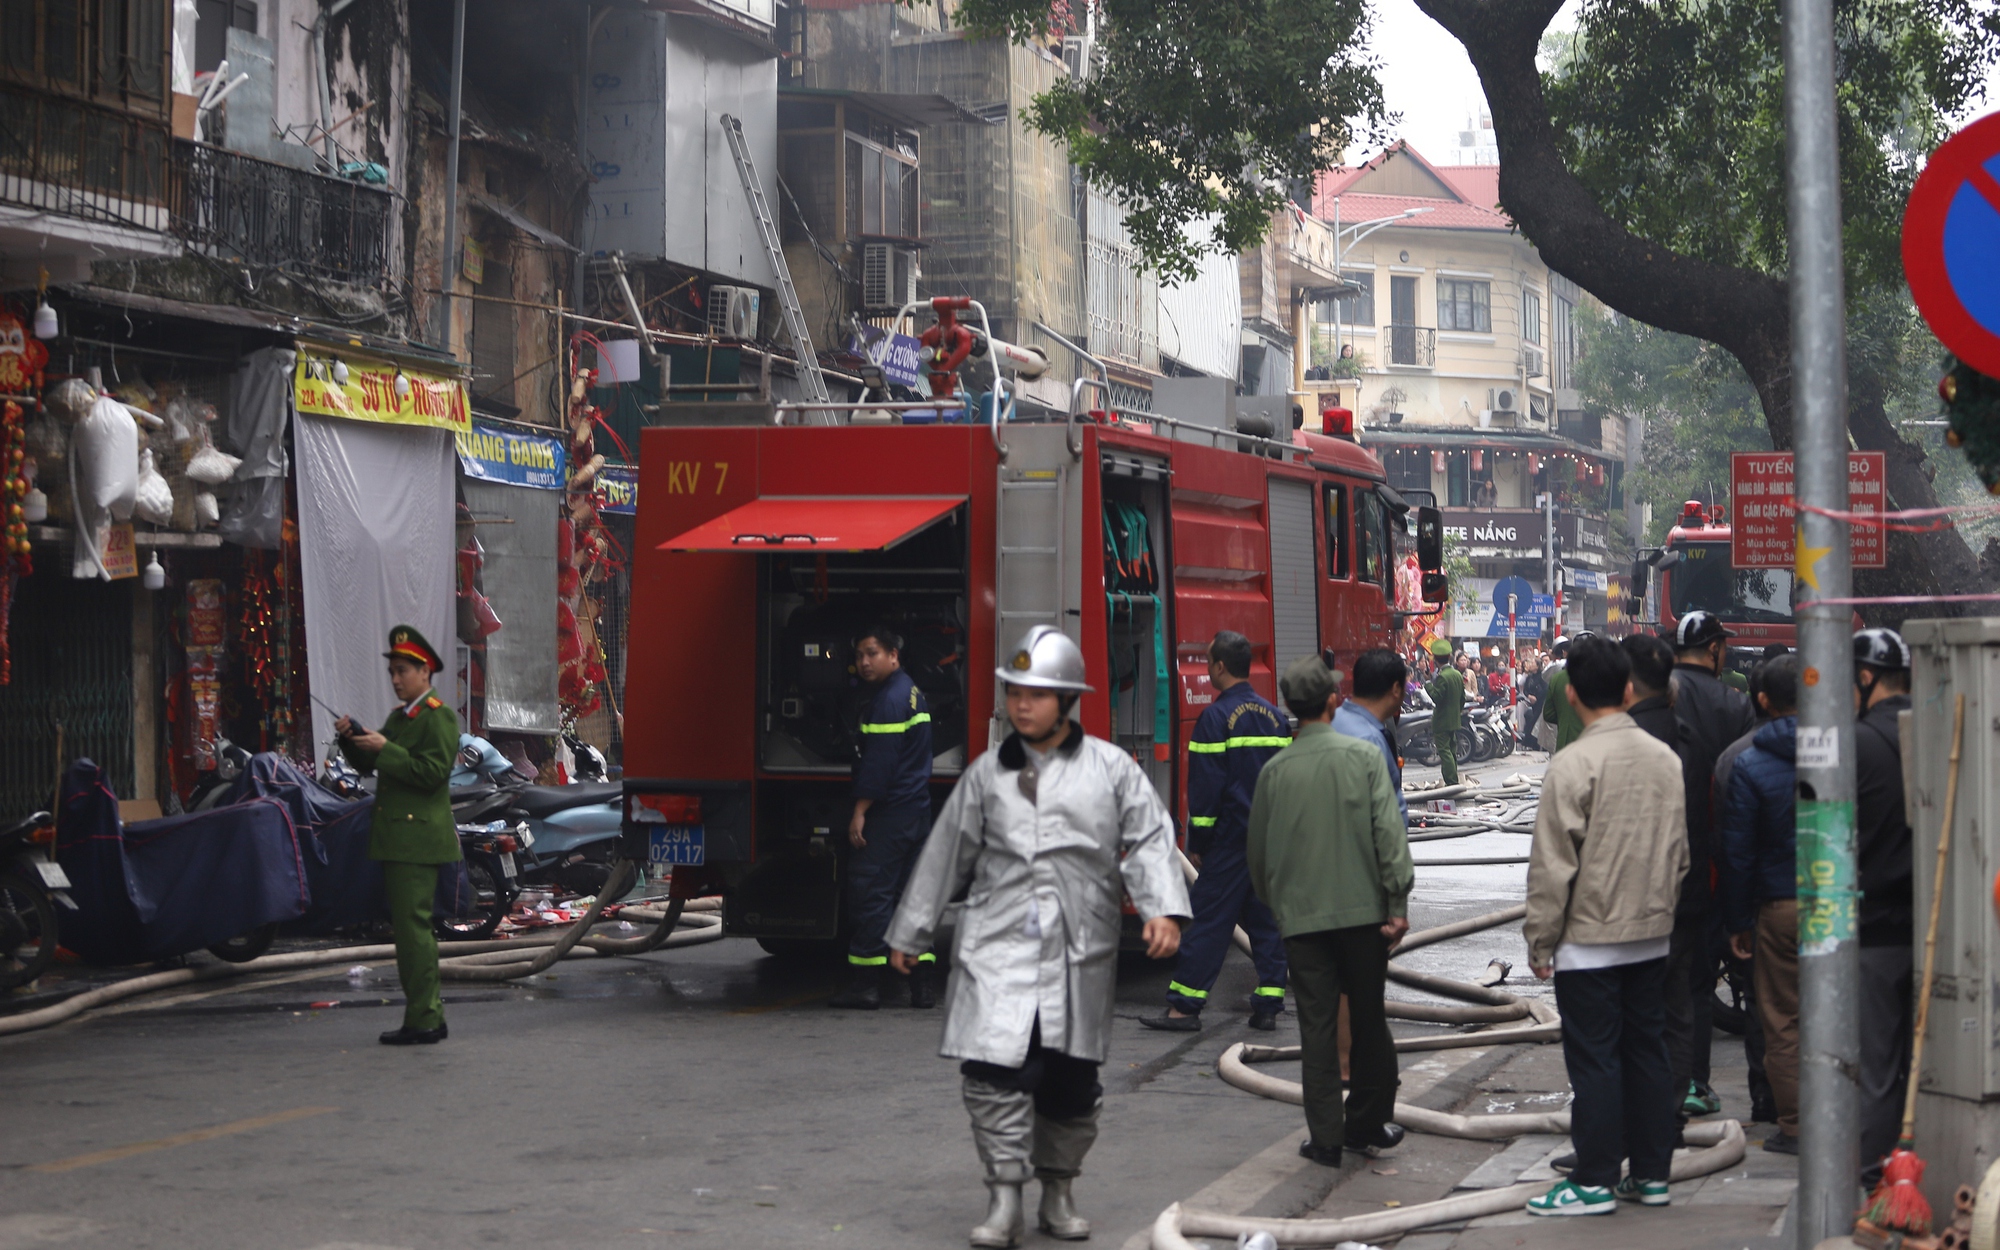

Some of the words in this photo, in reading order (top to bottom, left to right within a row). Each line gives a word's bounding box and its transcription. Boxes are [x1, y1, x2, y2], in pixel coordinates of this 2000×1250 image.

[893, 343, 920, 371] CƯỜNG
[509, 439, 556, 469] OANH
[1748, 457, 1794, 474] TUYẾN
[1849, 458, 1870, 476] BỘ
[668, 461, 701, 494] KV
[715, 462, 729, 495] 7
[1737, 480, 1752, 495] HÀNG
[1769, 480, 1785, 495] HÀNG
[1865, 480, 1880, 494] XUÂN
[1746, 524, 1763, 534] Mùa
[1850, 525, 1865, 534] 24h
[1866, 525, 1877, 534] 00
[1747, 538, 1763, 548] Mùa
[1766, 538, 1789, 550] đông:
[1850, 538, 1865, 547] 24h
[1866, 538, 1877, 547] 00
[1688, 549, 1706, 559] KV7
[1746, 552, 1766, 564] ngày
[1784, 552, 1795, 562] Sá
[1858, 553, 1876, 564] nhật
[663, 826, 691, 843] 29A
[651, 844, 702, 863] 021.17
